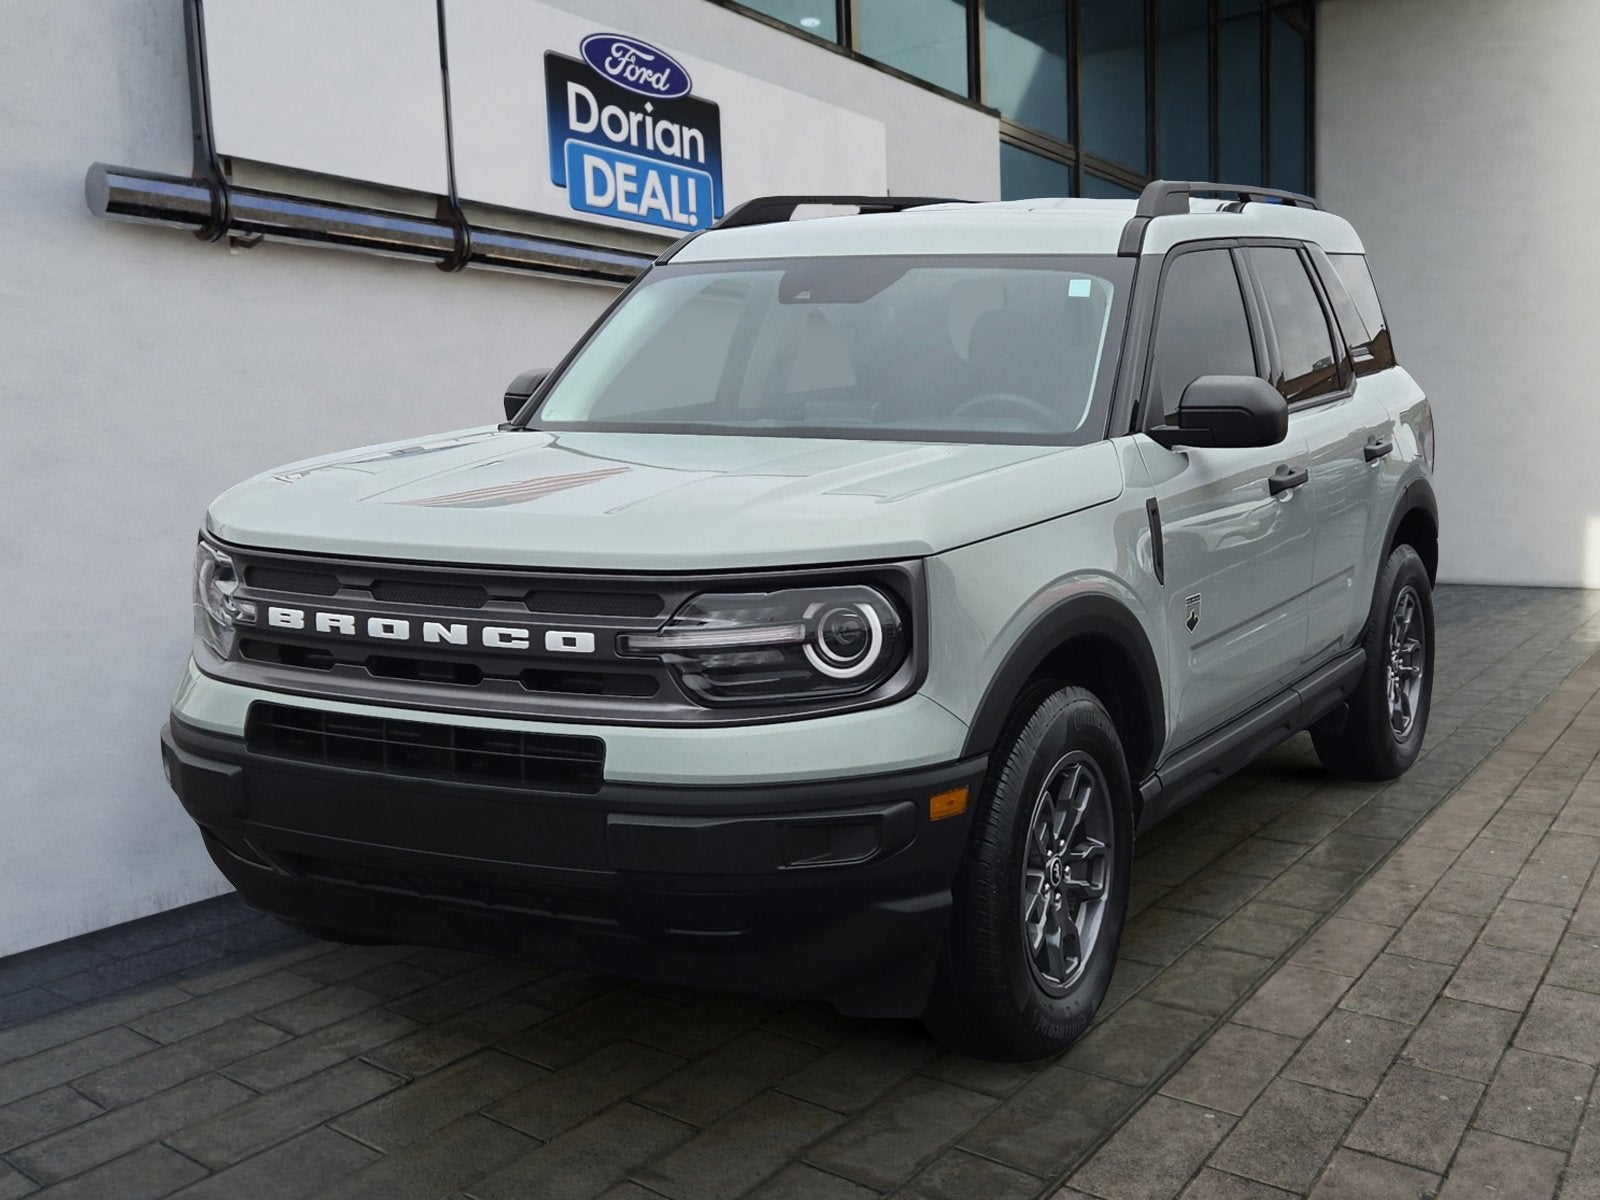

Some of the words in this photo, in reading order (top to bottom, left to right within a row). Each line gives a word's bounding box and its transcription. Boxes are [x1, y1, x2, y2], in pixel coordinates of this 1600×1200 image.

[604, 42, 671, 91] Ford
[567, 81, 705, 164] Dorian
[583, 153, 698, 226] DEAL!
[268, 606, 595, 653] BRONCO
